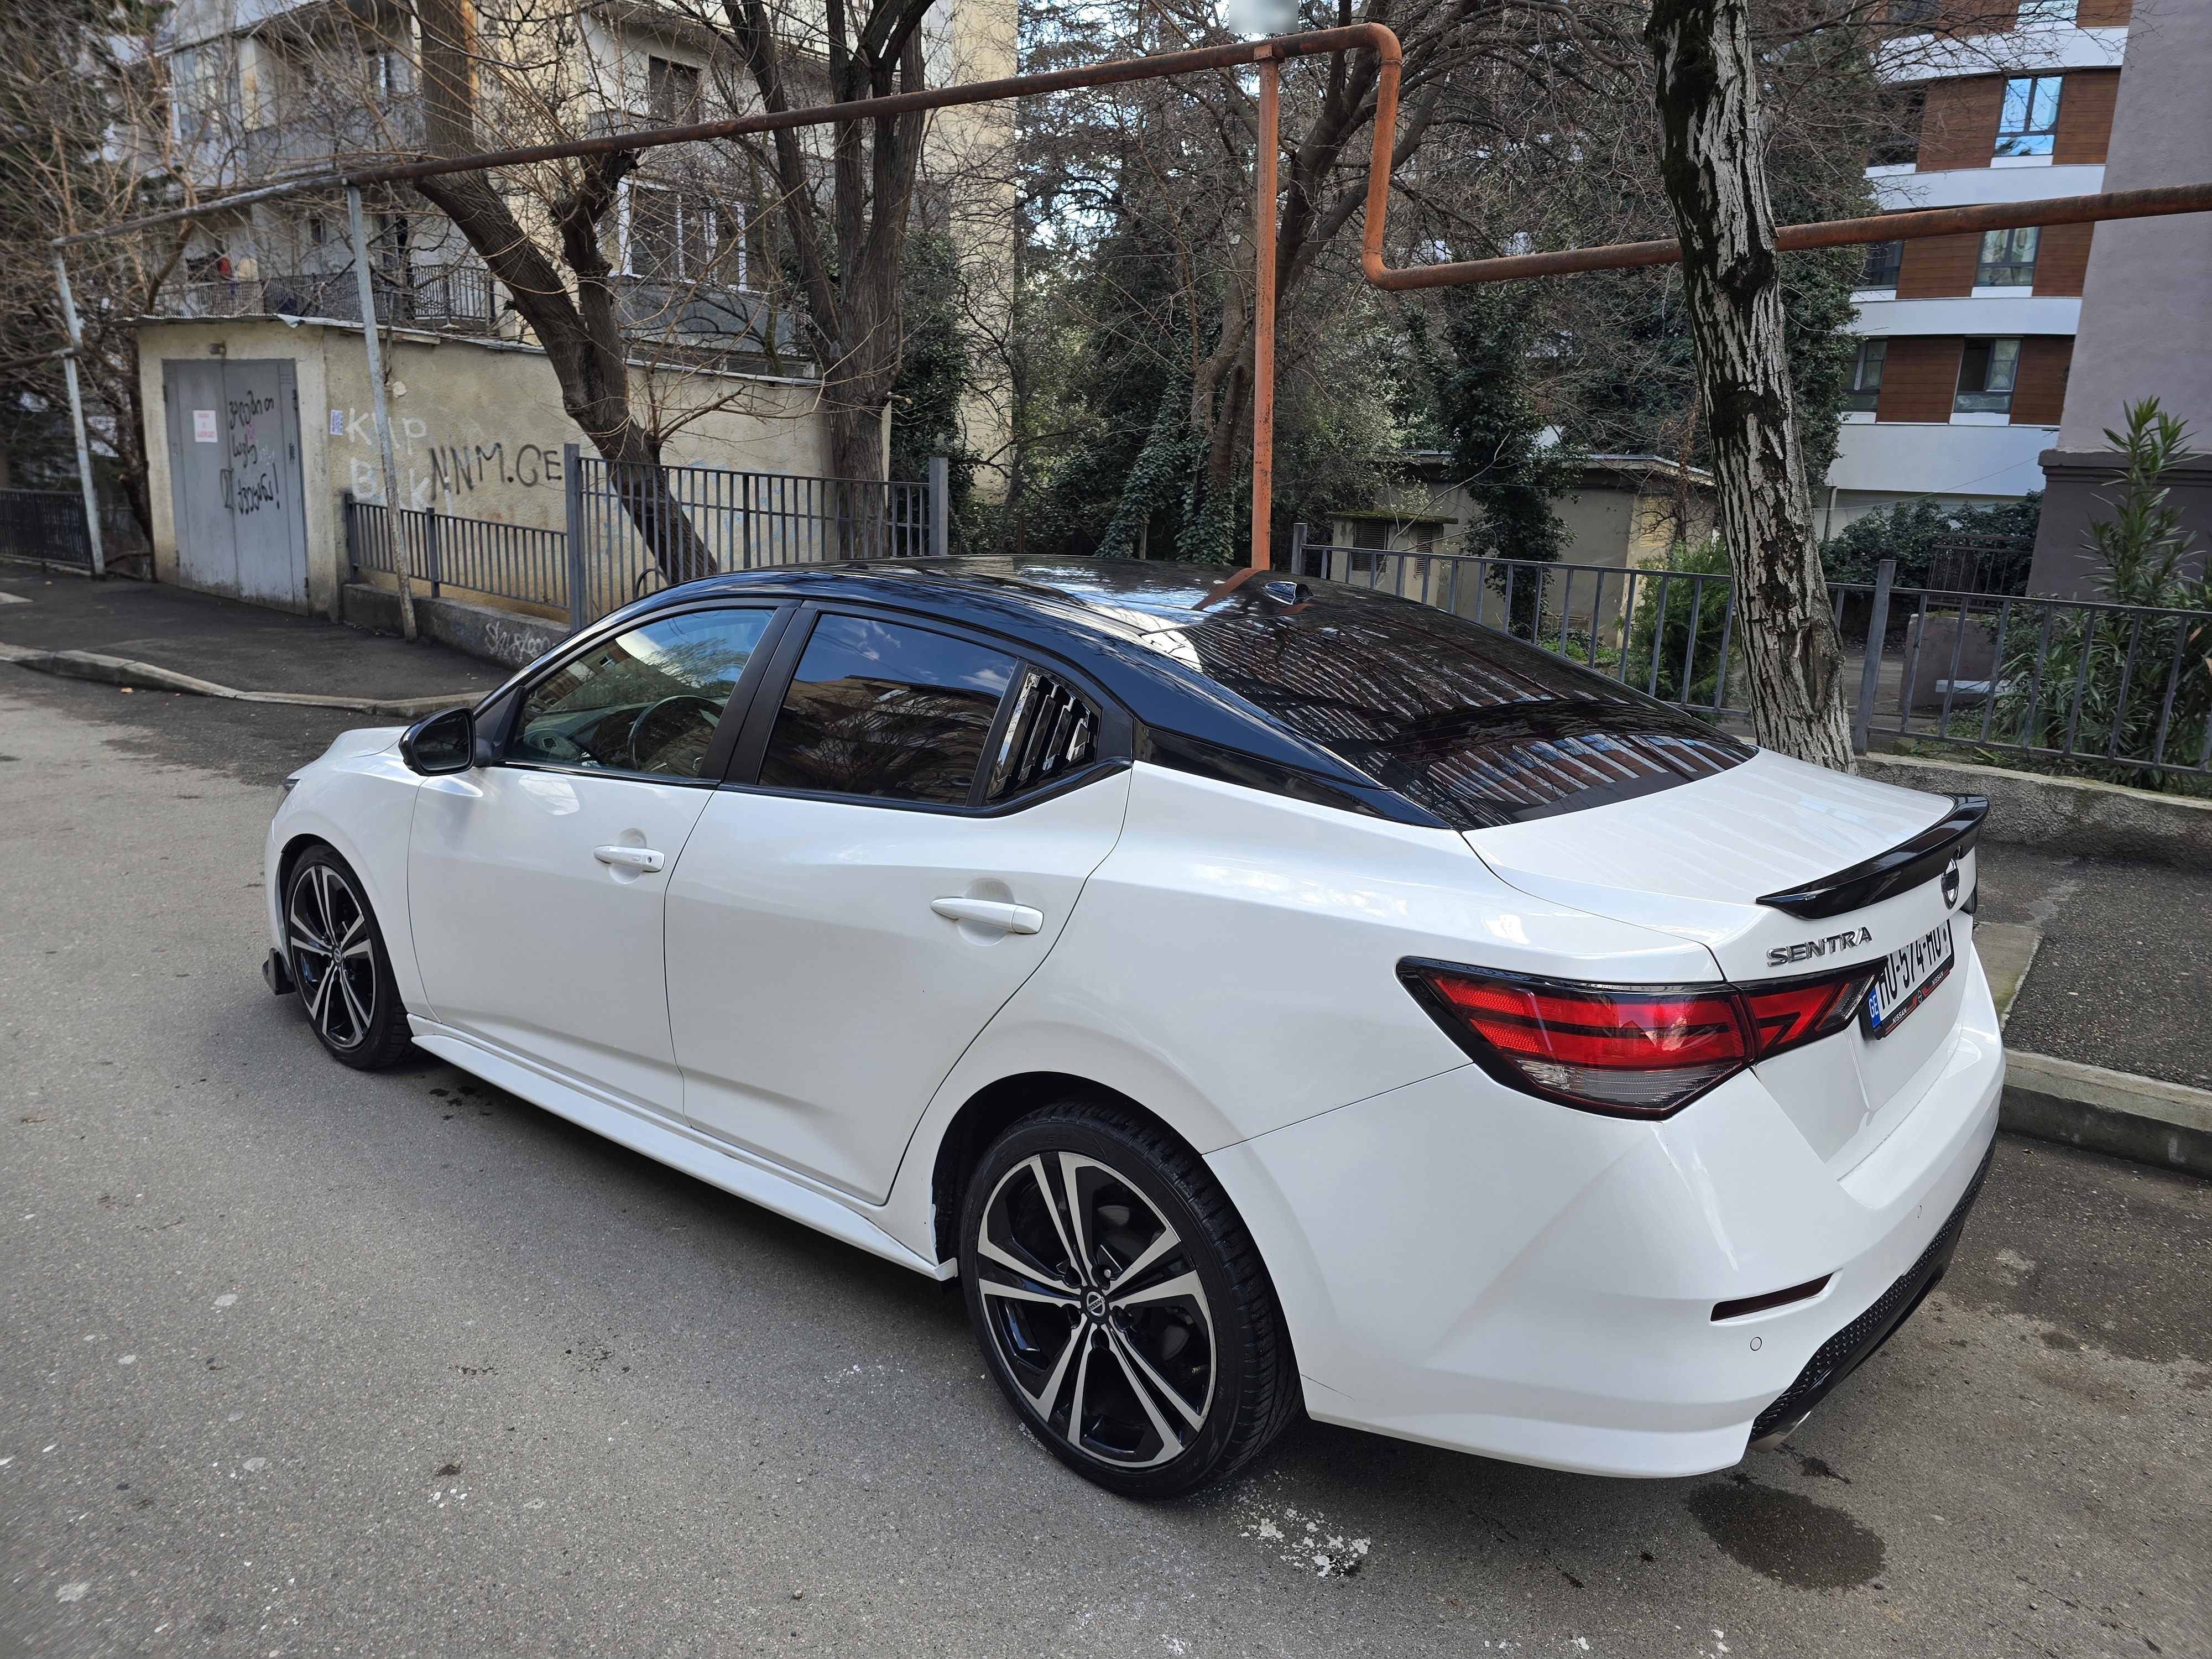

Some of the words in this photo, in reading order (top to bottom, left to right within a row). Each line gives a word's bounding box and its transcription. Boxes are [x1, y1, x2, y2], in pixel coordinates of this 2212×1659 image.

[1766, 926, 1872, 967] SENTRA
[1932, 970, 1944, 987] NISSAN
[1869, 994, 1879, 1018] GE
[1892, 1006, 1907, 1025] NISSAN
